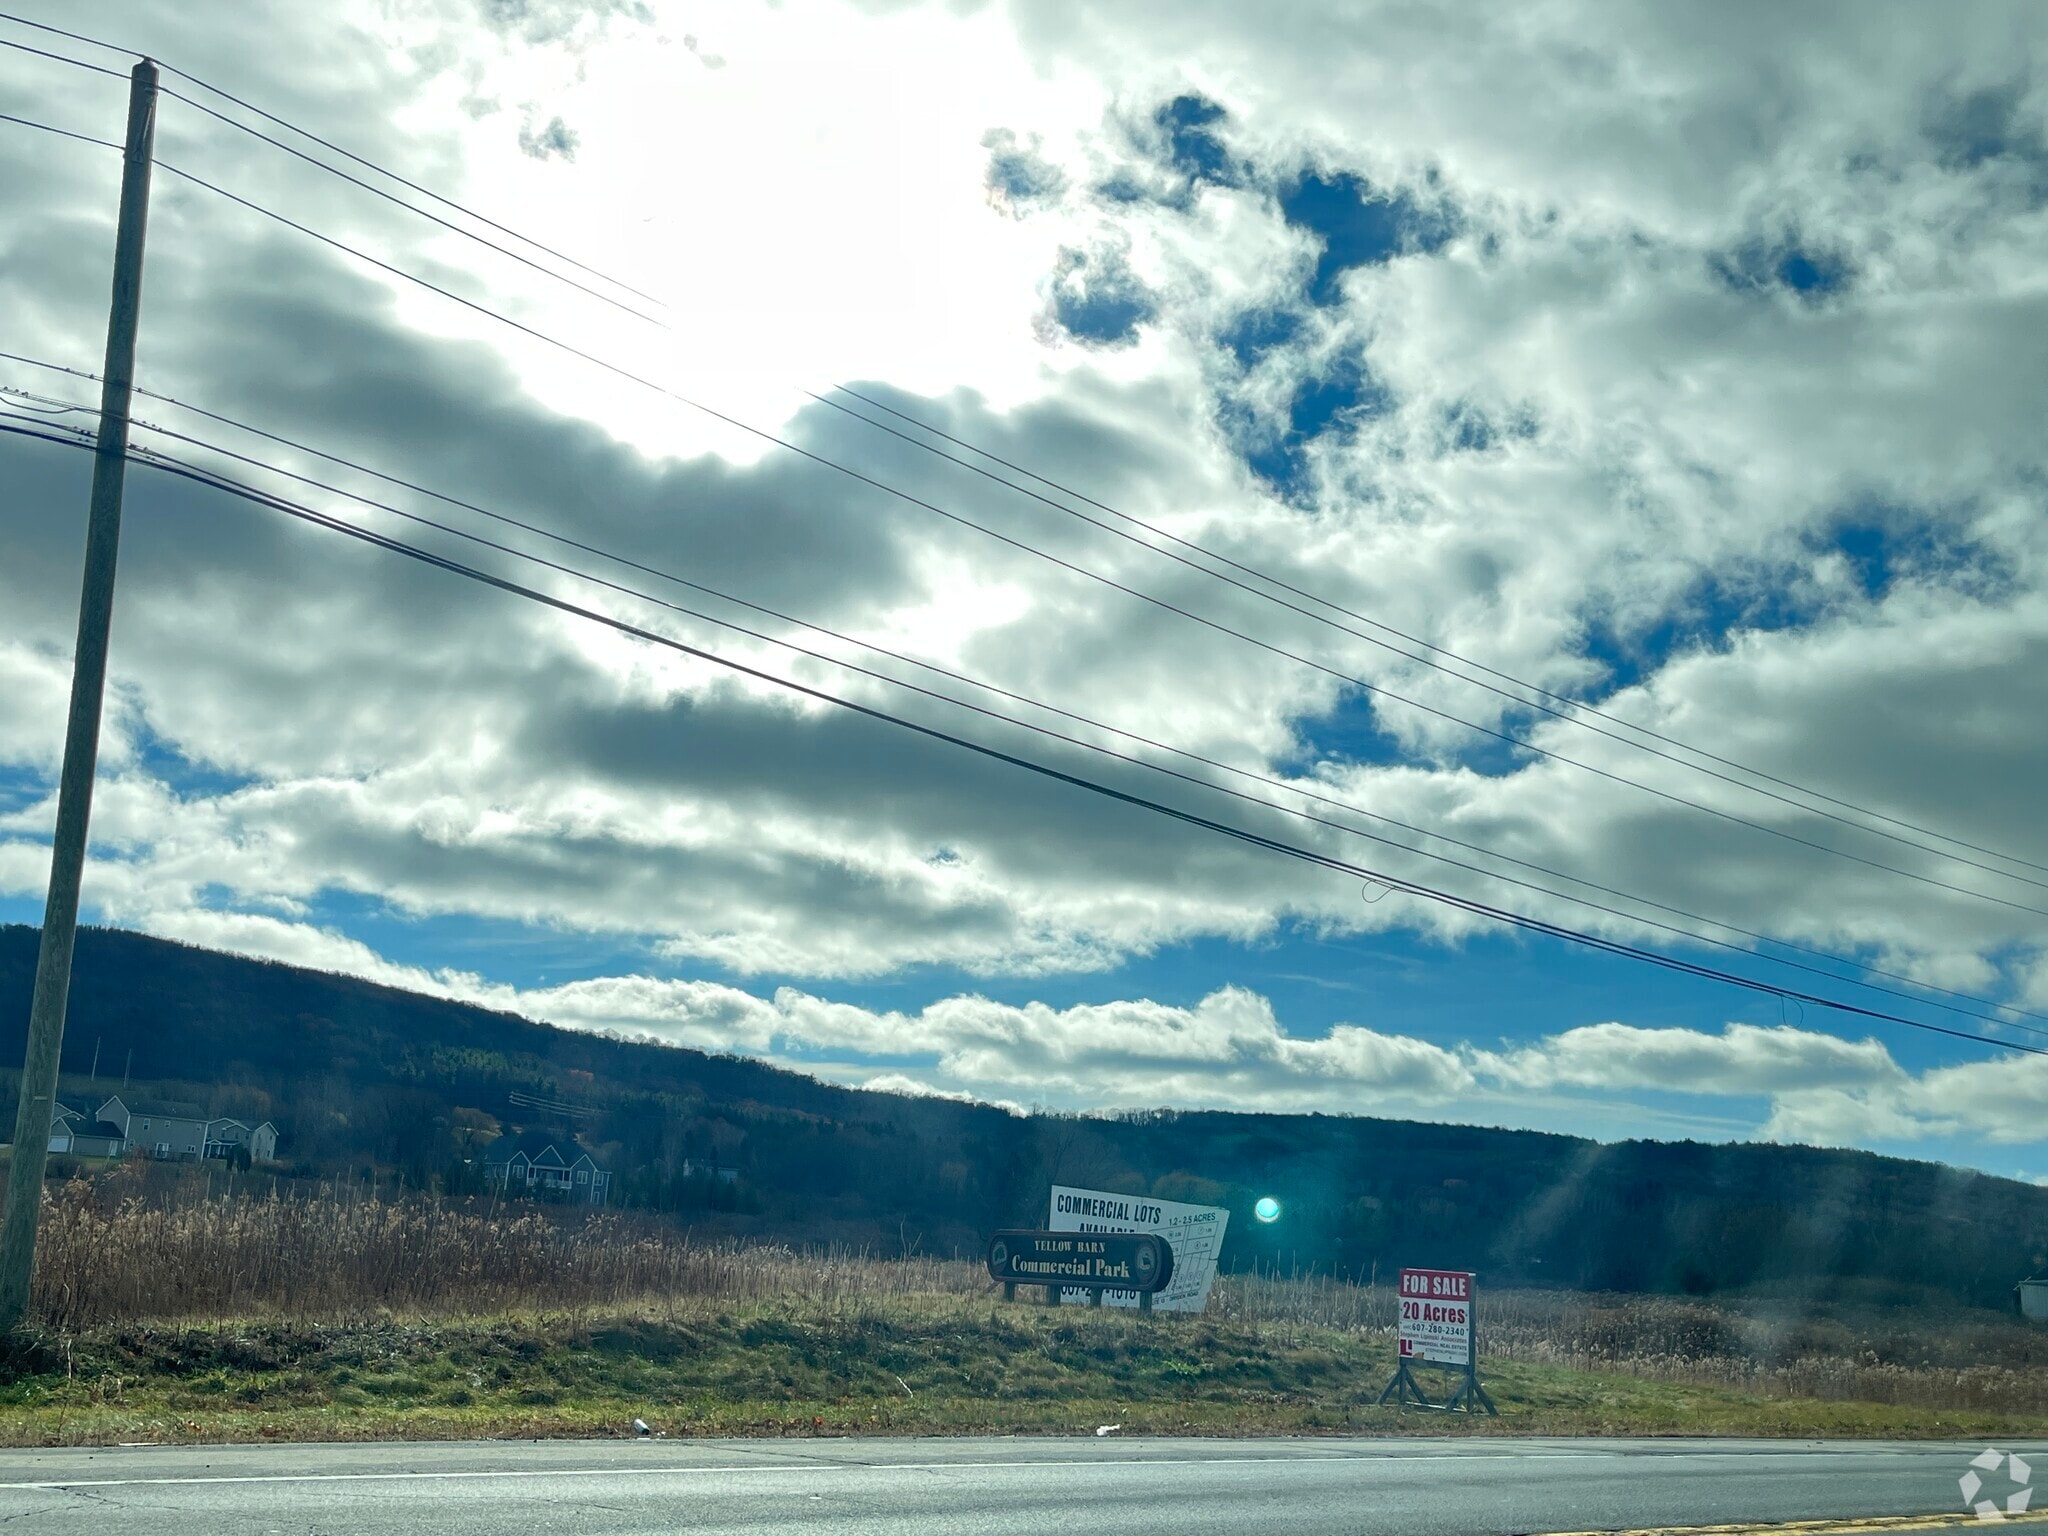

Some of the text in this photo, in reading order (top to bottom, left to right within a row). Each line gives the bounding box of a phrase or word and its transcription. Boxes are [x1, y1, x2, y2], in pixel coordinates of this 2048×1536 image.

[1057, 1194, 1162, 1225] COMMERCIAL LOTS
[1193, 1212, 1217, 1222] ACRES
[1034, 1240, 1106, 1254] YELLOW BARN
[1012, 1254, 1131, 1278] Commercial Park
[1403, 1274, 1467, 1297] FOR SALE
[1403, 1301, 1466, 1324] 20 Acres
[1411, 1323, 1465, 1336] 607-280-2340
